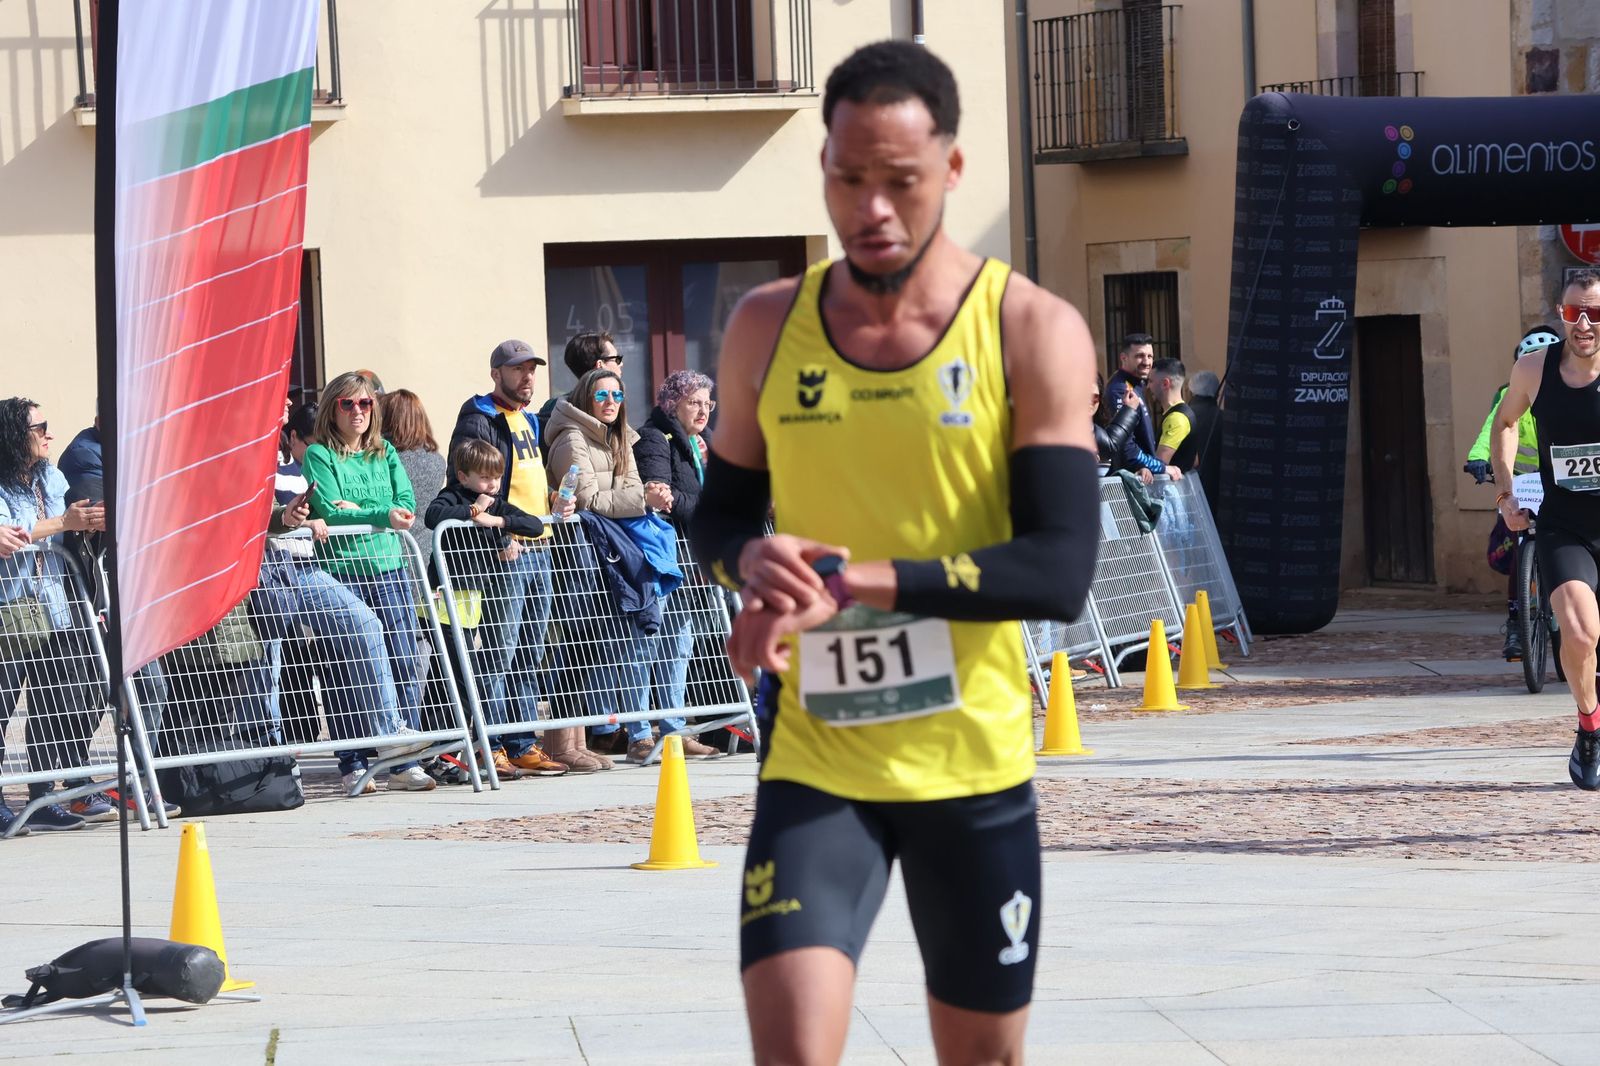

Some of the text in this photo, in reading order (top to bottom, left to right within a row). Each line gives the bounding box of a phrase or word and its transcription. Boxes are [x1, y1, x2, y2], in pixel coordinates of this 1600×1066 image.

[1294, 388, 1349, 403] ZAMORA
[1565, 456, 1600, 477] 226
[826, 628, 915, 686] 151
